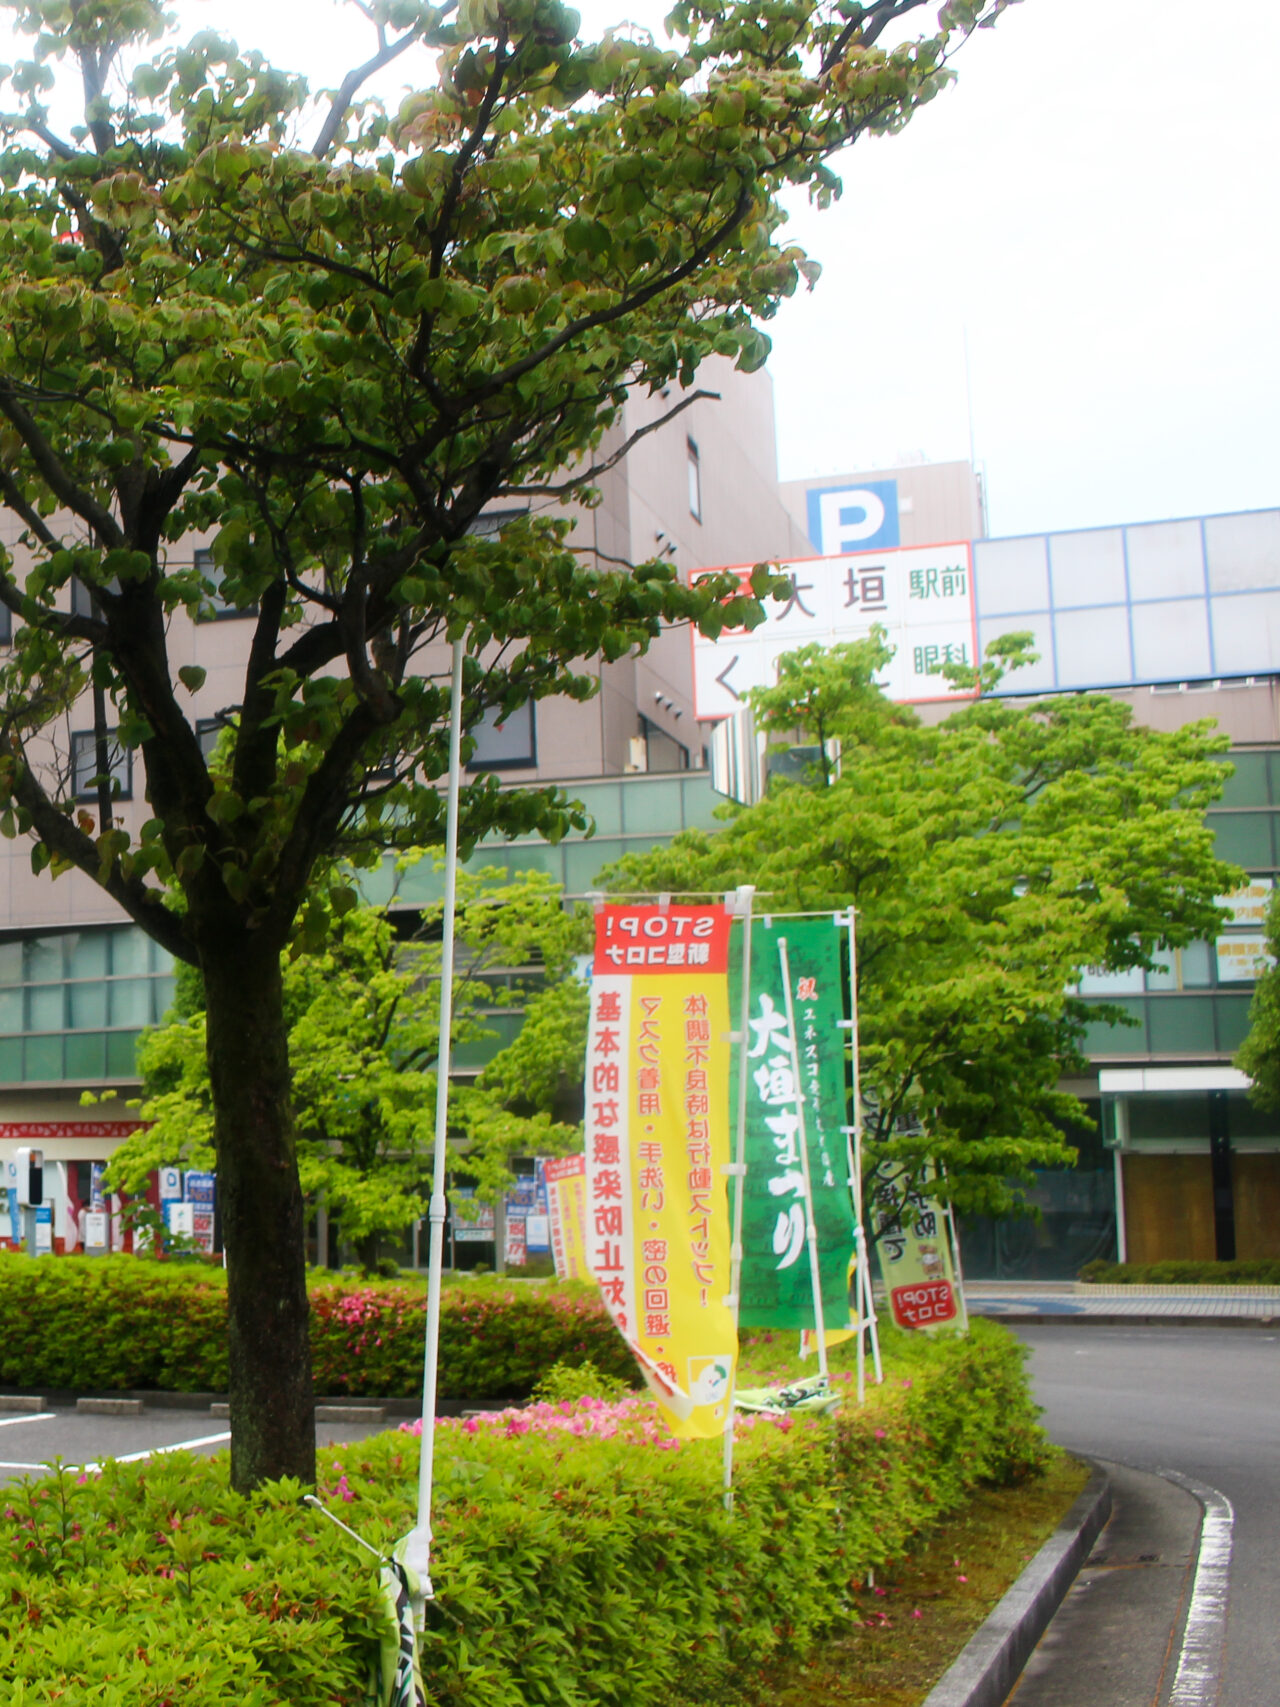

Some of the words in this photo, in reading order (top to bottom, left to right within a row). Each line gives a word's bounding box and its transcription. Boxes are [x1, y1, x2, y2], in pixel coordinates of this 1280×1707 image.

[820, 489, 885, 556] P
[776, 565, 888, 621] 大垣
[909, 564, 966, 600] 駅前
[913, 643, 968, 676] 眼科
[796, 976, 819, 1001] 祝
[746, 993, 807, 1271] 大垣まつり
